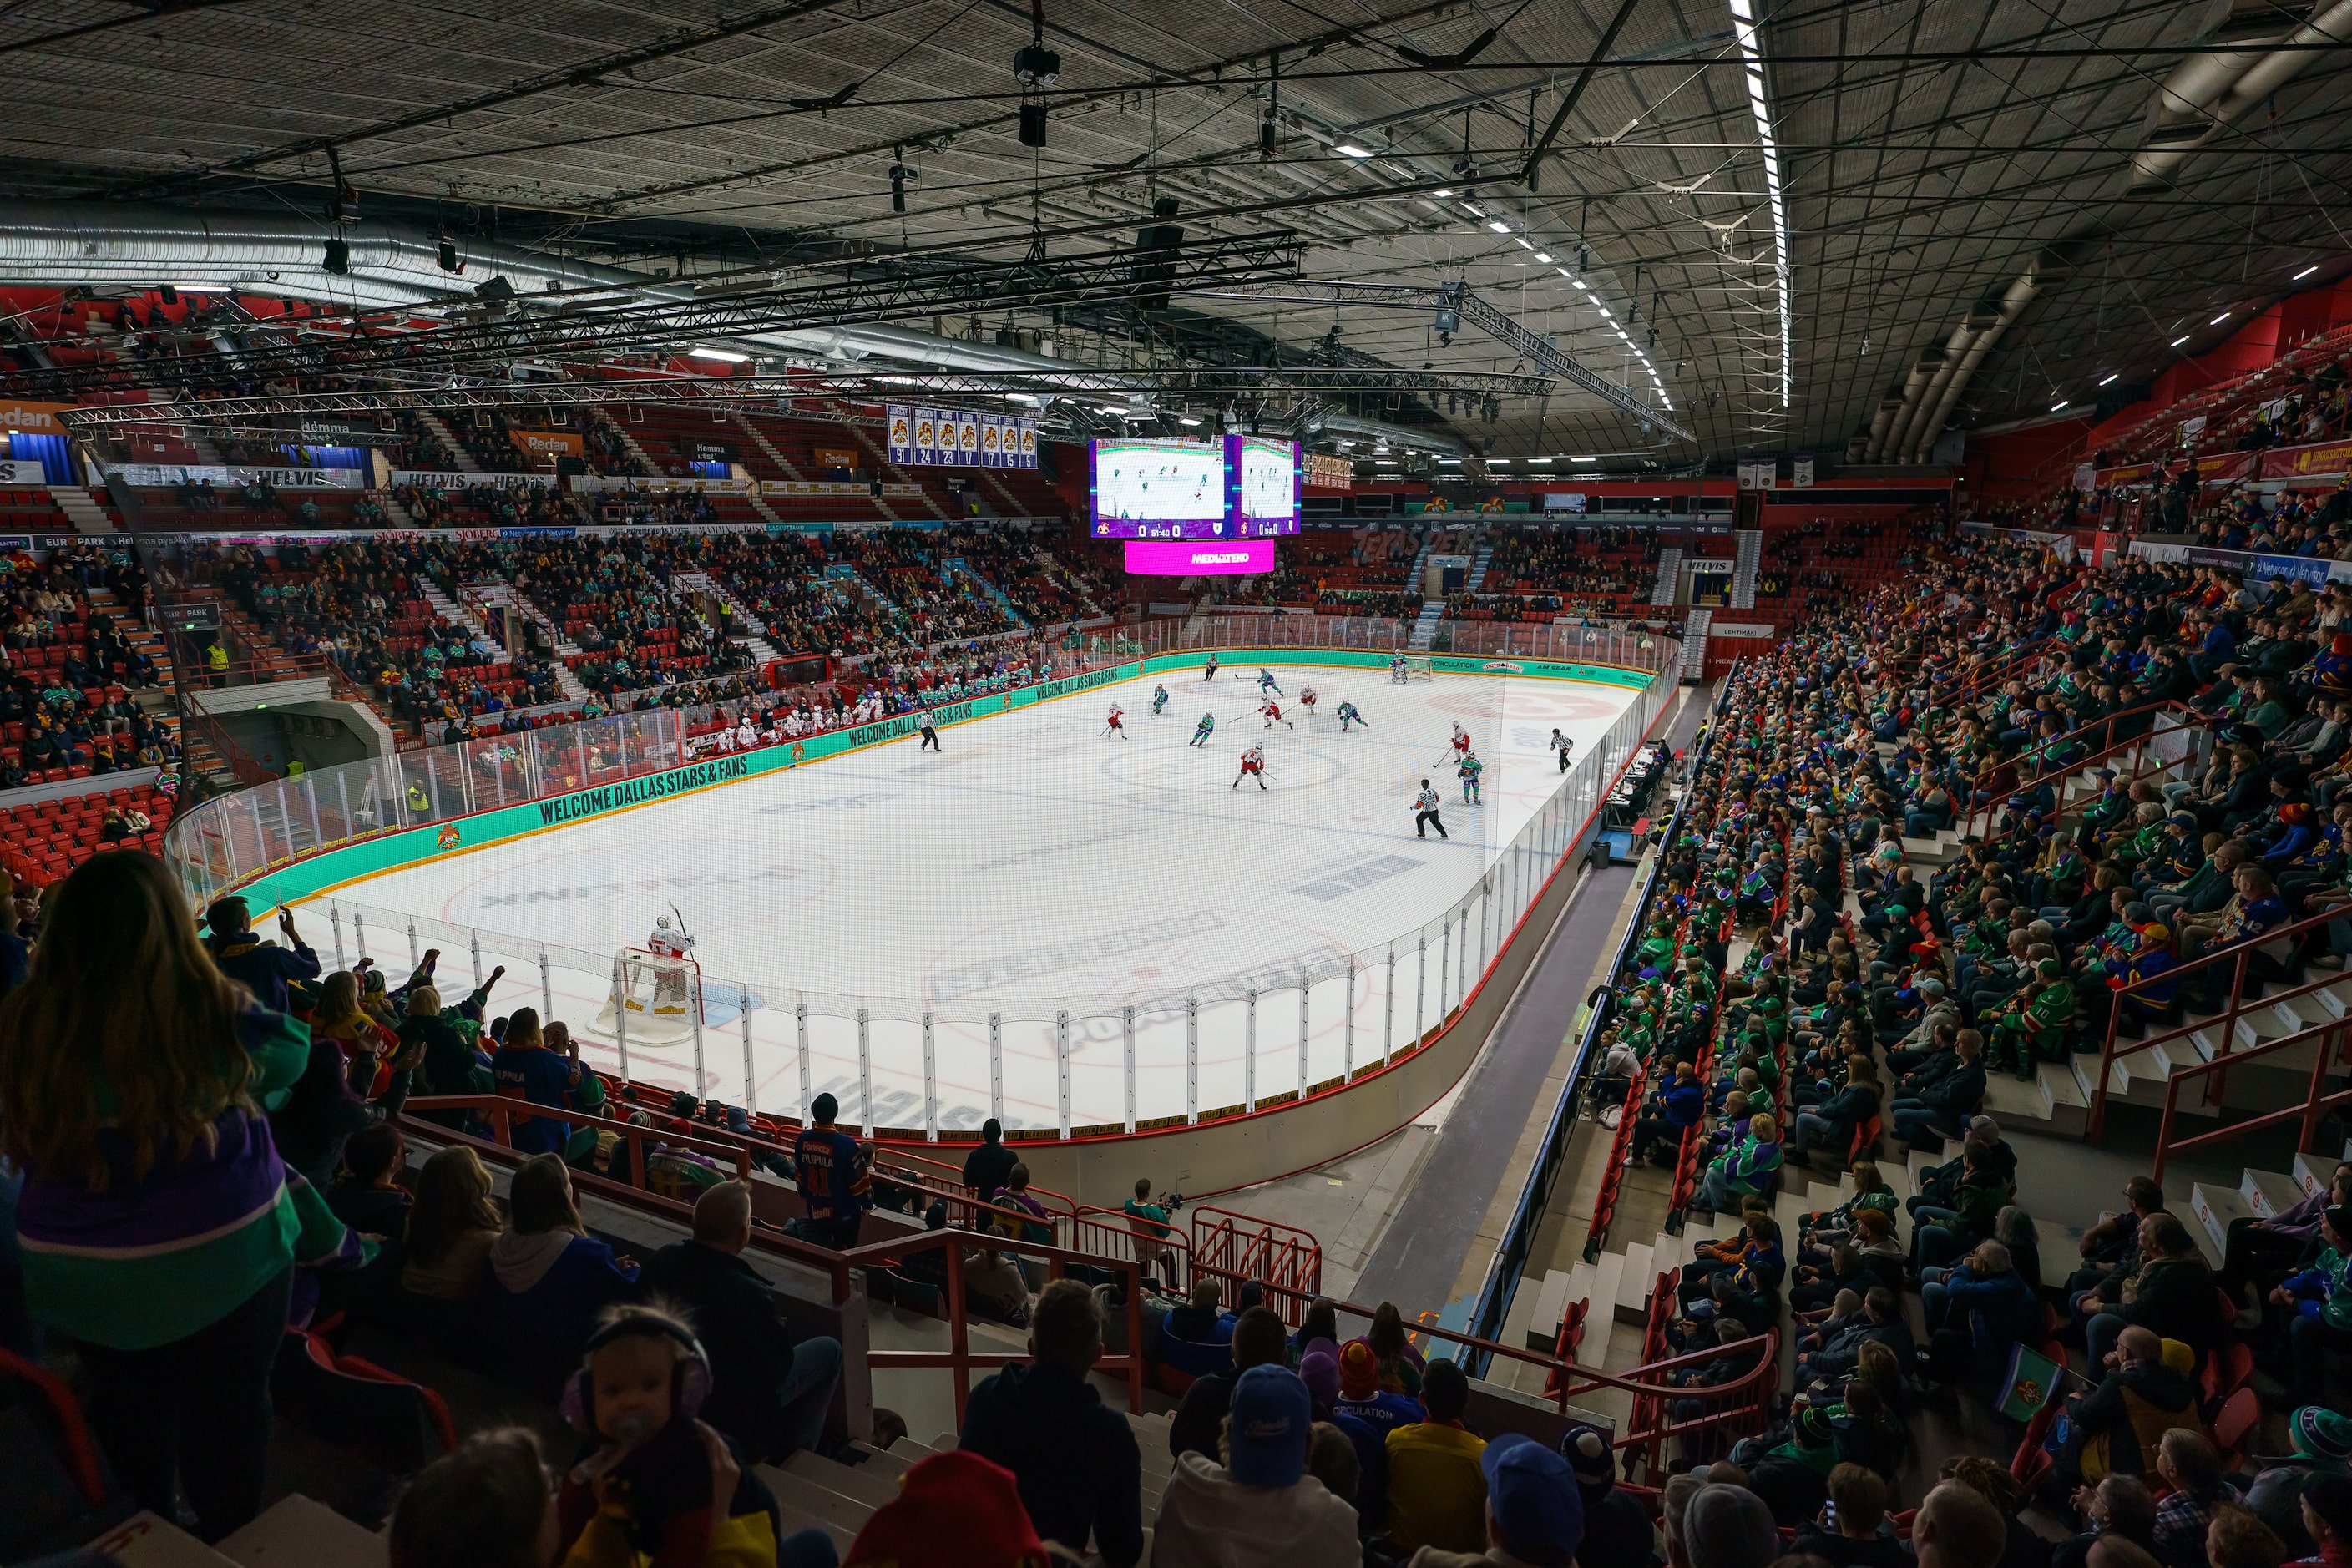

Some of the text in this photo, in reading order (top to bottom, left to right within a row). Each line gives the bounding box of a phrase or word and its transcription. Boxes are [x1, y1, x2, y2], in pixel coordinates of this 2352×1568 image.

[528, 436, 569, 451] Redan
[696, 443, 725, 453] Hemma
[825, 453, 850, 464] Redan
[896, 448, 905, 463] 91
[920, 450, 931, 464] 24
[943, 451, 953, 464] 23
[965, 453, 972, 465] 17
[987, 453, 994, 466] 17
[1007, 455, 1014, 467] 15
[1026, 456, 1031, 468] 5
[258, 470, 326, 486] HELVIS
[409, 474, 466, 488] HELVIS
[1139, 525, 1146, 538] 0
[1172, 524, 1181, 537] 0
[1259, 524, 1264, 535] 0
[1273, 523, 1277, 534] 0
[1688, 561, 1727, 571] HELVIS
[2263, 561, 2324, 584] Netvisor Netvisor
[1036, 669, 1117, 700] WELCOME DALLAS STARS & FANS
[849, 721, 891, 746] WELCOME
[948, 708, 953, 721] &
[954, 703, 972, 720] FANS
[539, 756, 747, 825] WELCOME DALLAS STARS & FANS
[803, 1141, 831, 1154] Fonecta
